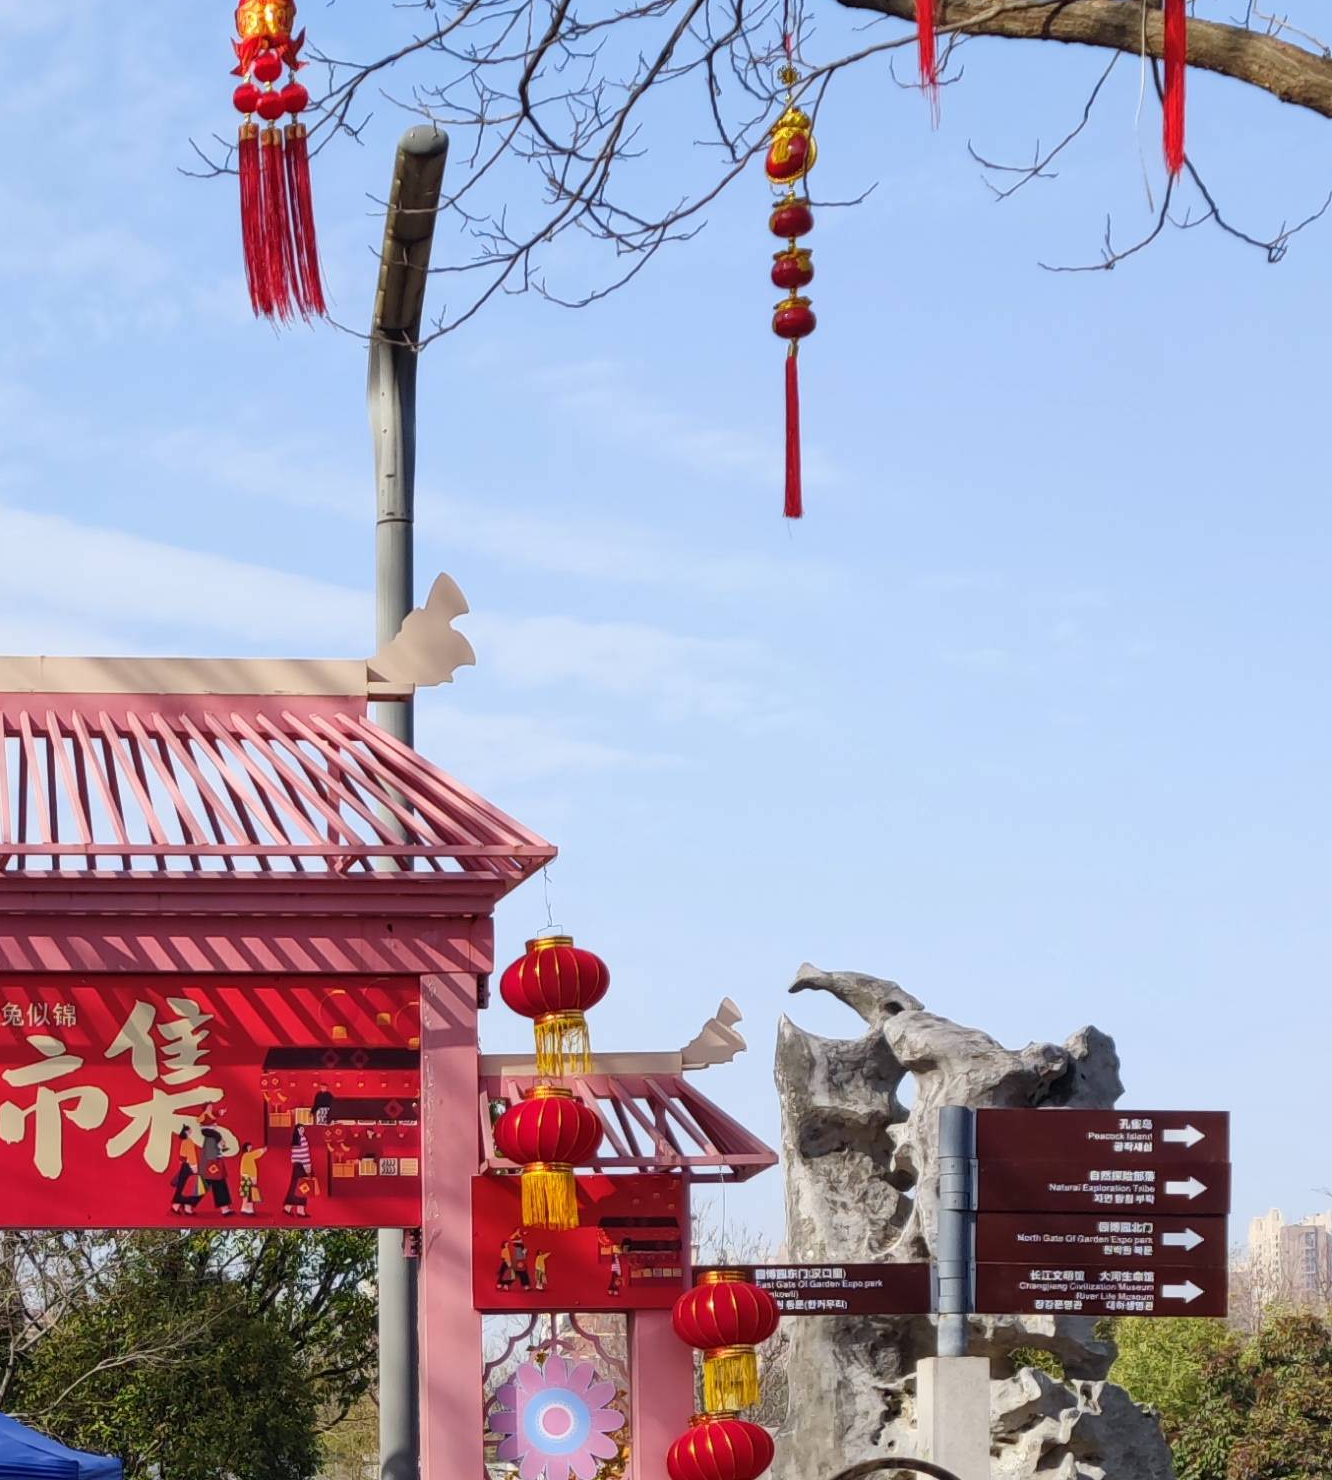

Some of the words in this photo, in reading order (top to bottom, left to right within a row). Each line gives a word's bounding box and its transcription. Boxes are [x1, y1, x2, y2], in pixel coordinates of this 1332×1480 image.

[1119, 1119, 1153, 1129] 孔雀岛
[1088, 1132, 1124, 1140] Peacock
[1126, 1132, 1153, 1140] Island
[1049, 1183, 1080, 1192] Natural
[1082, 1183, 1131, 1193] Exploration
[1133, 1184, 1155, 1192] Tribe
[1098, 1222, 1153, 1233] 园博园北门
[1018, 1234, 1041, 1242] North
[1043, 1234, 1064, 1242] Gate
[1077, 1235, 1109, 1243] Garden
[1111, 1236, 1132, 1245] Expo
[1030, 1270, 1085, 1281] 长江文明馆
[1099, 1271, 1155, 1282] 大河生命馆
[756, 1280, 774, 1288] East
[776, 1280, 796, 1288] Gate
[810, 1280, 840, 1288] Garden
[842, 1280, 863, 1289] Expo
[865, 1279, 883, 1289] park
[1019, 1282, 1068, 1292] Changjiang
[1069, 1282, 1116, 1291] Civilization
[1118, 1283, 1154, 1291] Museum
[1076, 1292, 1100, 1300] River
[1100, 1292, 1116, 1300] Life
[1118, 1292, 1154, 1300] Museum
